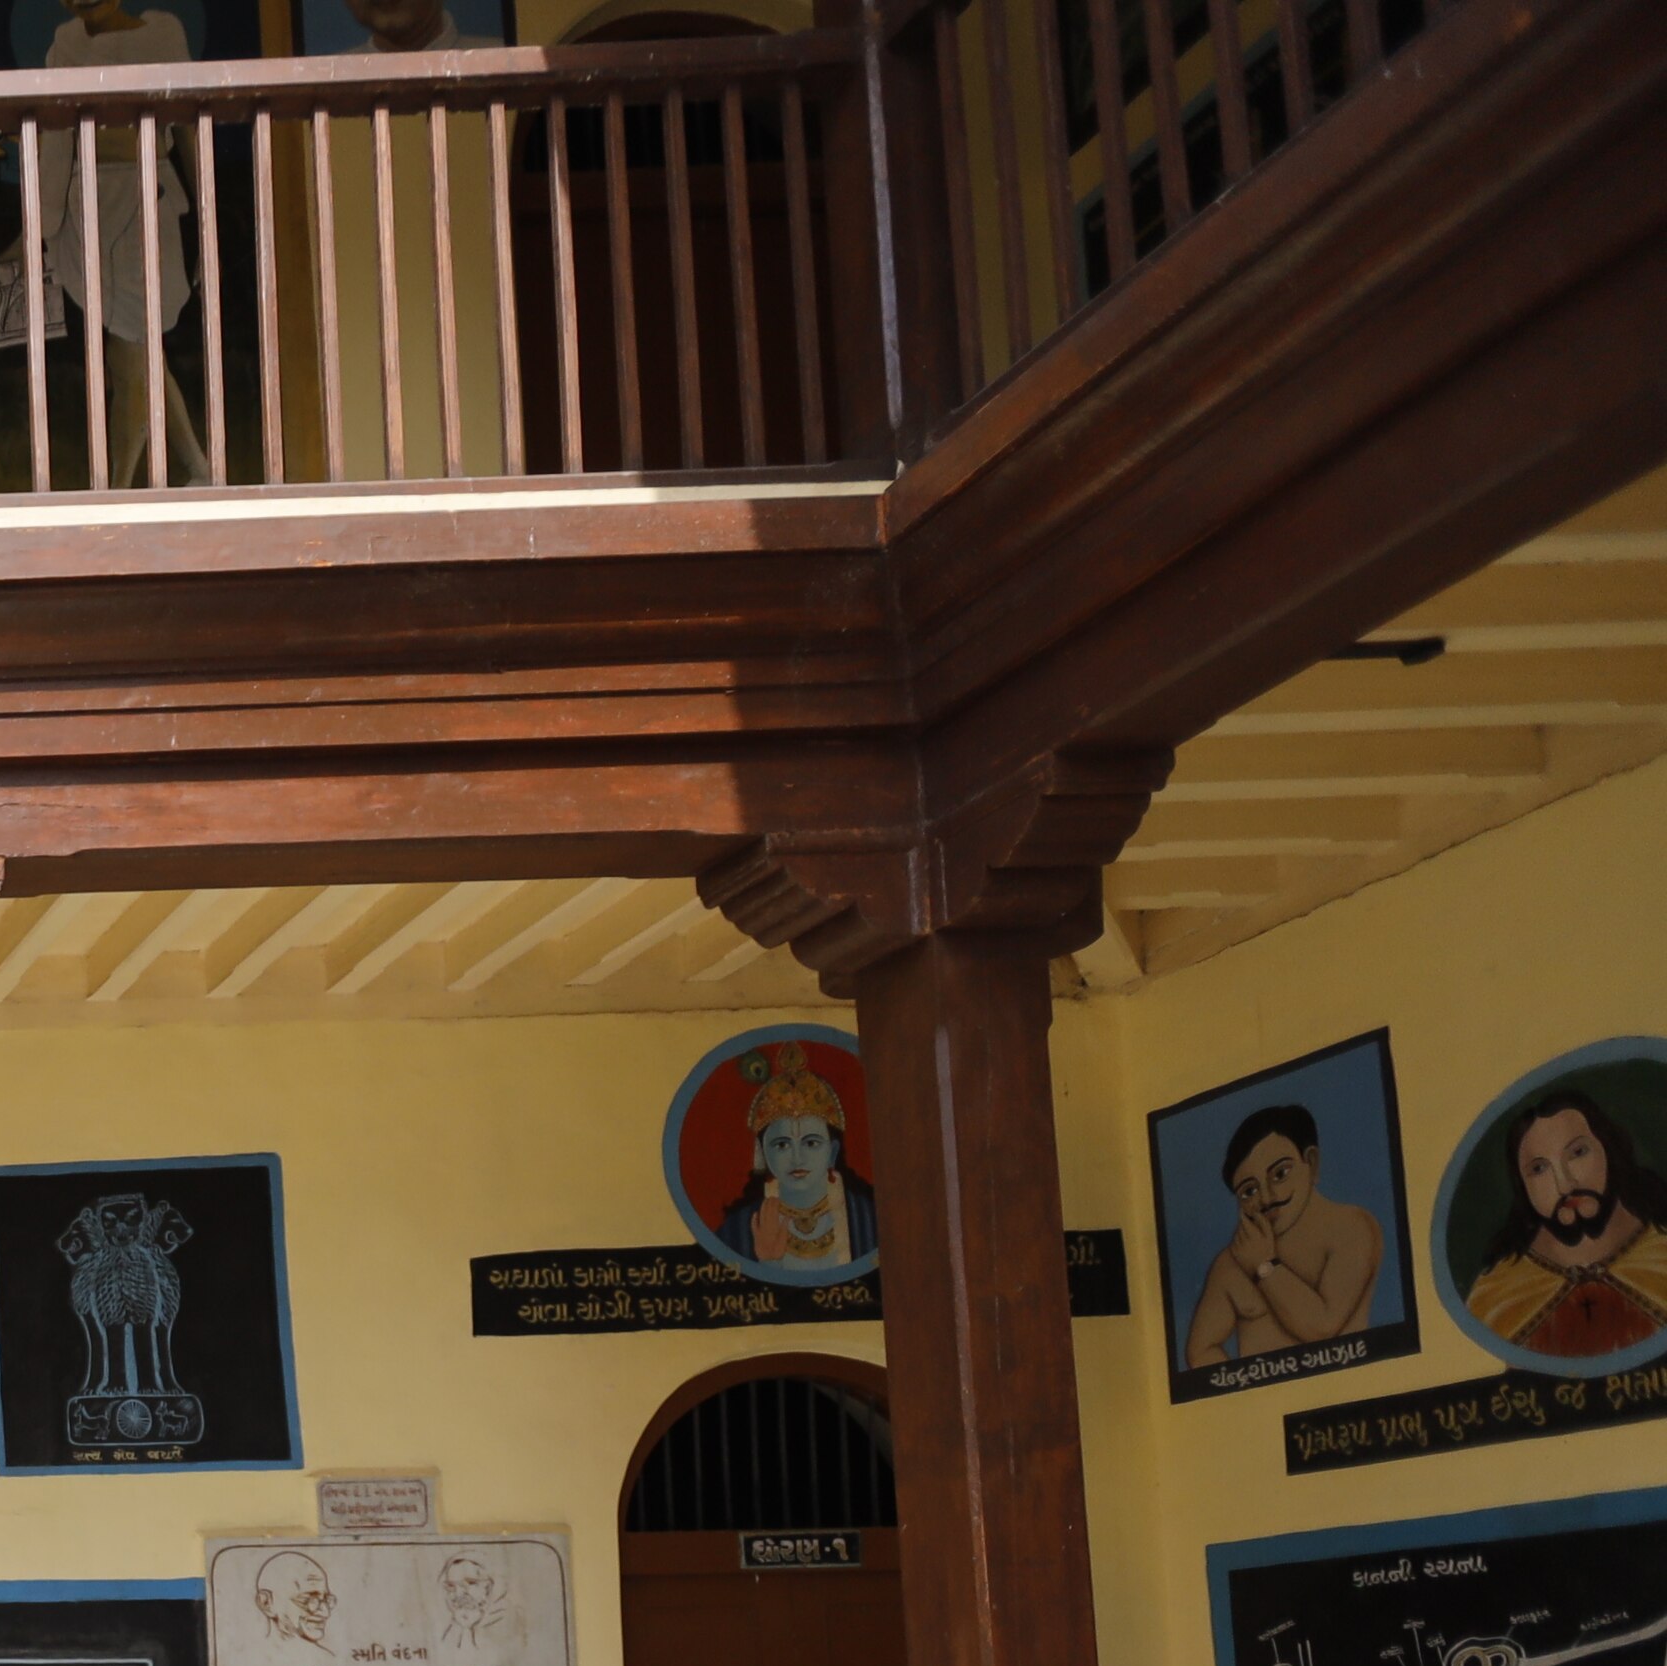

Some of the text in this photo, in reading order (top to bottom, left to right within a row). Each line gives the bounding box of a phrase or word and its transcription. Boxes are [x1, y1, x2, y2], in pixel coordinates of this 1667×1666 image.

[1377, 1410, 1429, 1448] પ્રભુ
[1351, 1554, 1489, 1588] કાનની રચના
[392, 1646, 429, 1662] વંદના
